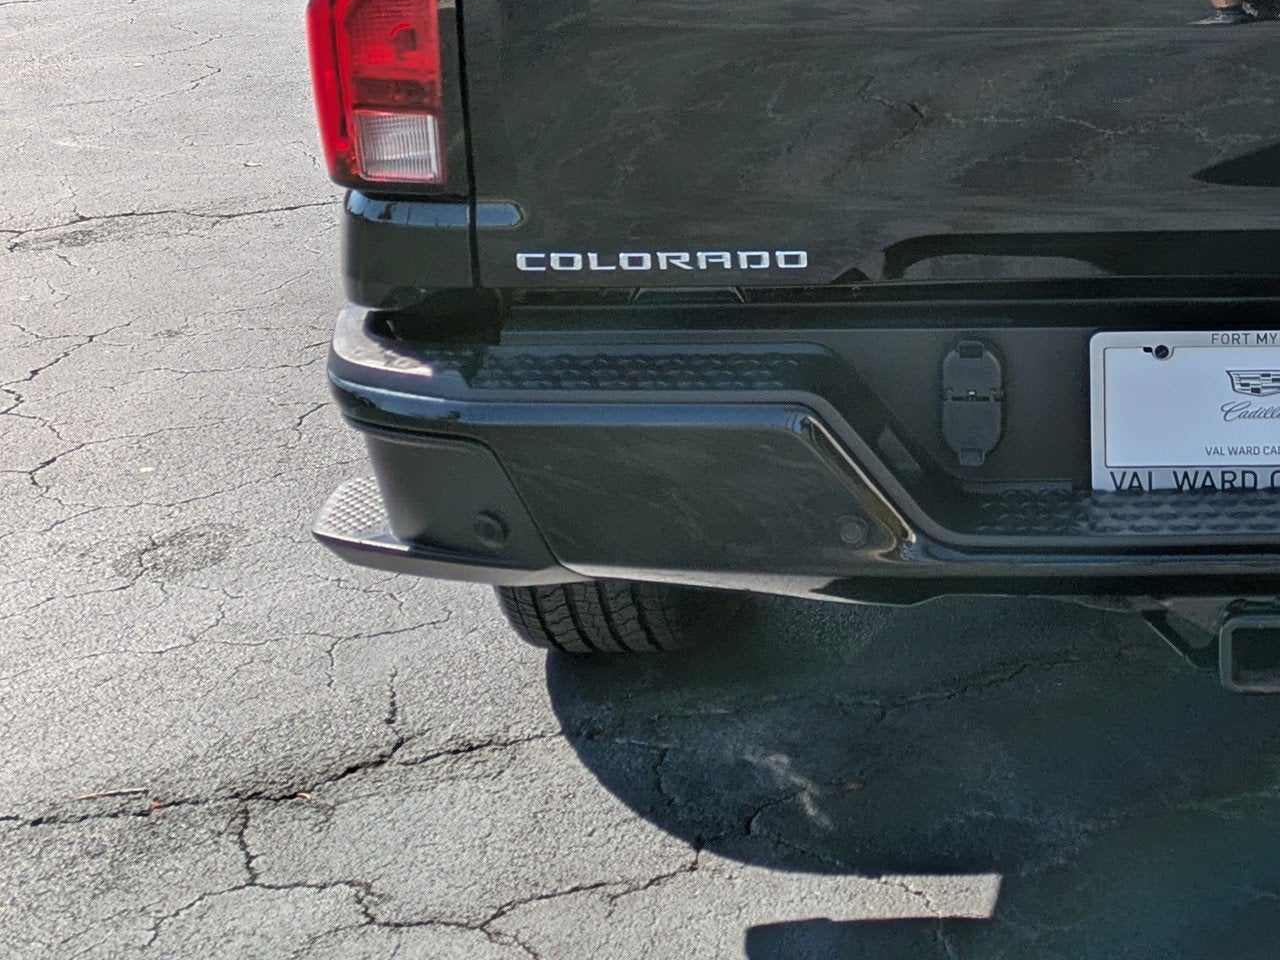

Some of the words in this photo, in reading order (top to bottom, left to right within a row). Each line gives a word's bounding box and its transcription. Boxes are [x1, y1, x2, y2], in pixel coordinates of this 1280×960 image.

[515, 250, 809, 272] COLORADO
[1211, 333, 1250, 346] FORT
[1205, 446, 1225, 457] VAL
[1228, 446, 1261, 457] WARD
[1110, 471, 1153, 491] VAL
[1172, 470, 1259, 491] WARD
